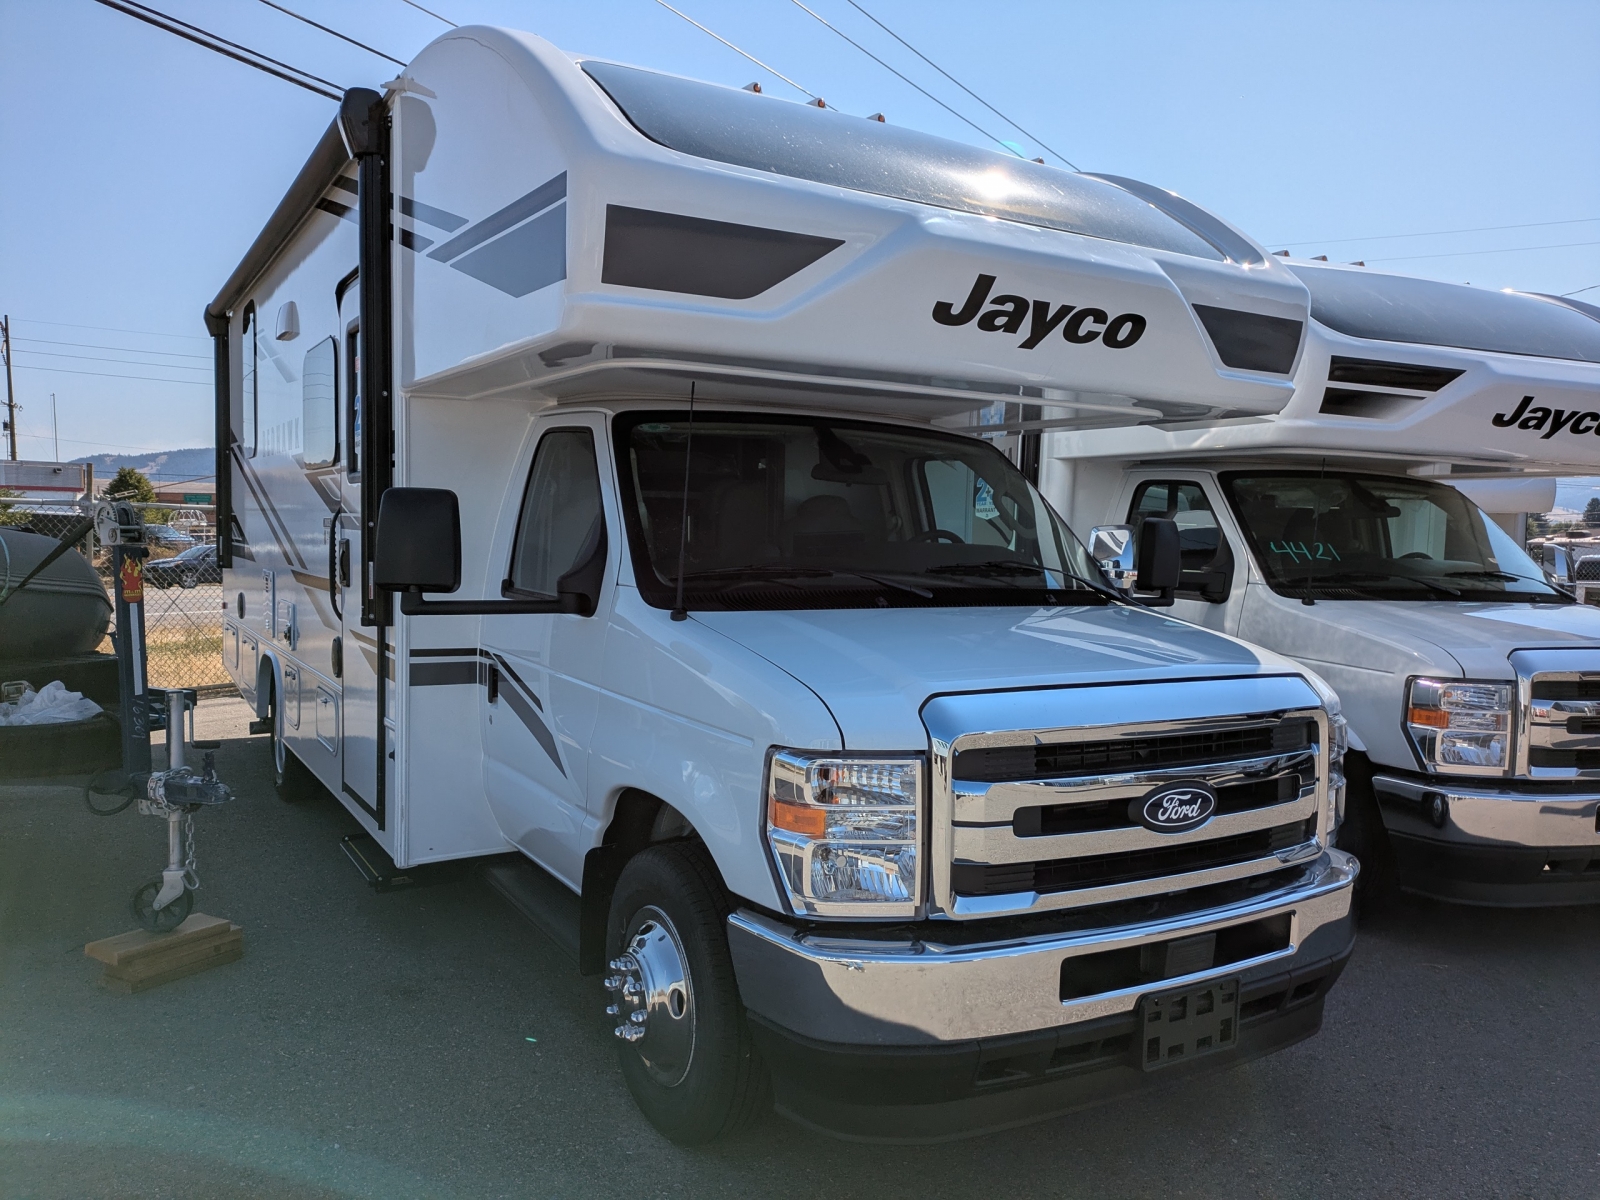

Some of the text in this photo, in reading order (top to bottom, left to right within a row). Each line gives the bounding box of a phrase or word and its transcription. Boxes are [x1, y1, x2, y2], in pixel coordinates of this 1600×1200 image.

[932, 273, 1147, 350] Jayco
[1492, 395, 1600, 440] Jayc
[1270, 540, 1341, 564] 4421
[1158, 793, 1202, 821] Ford
